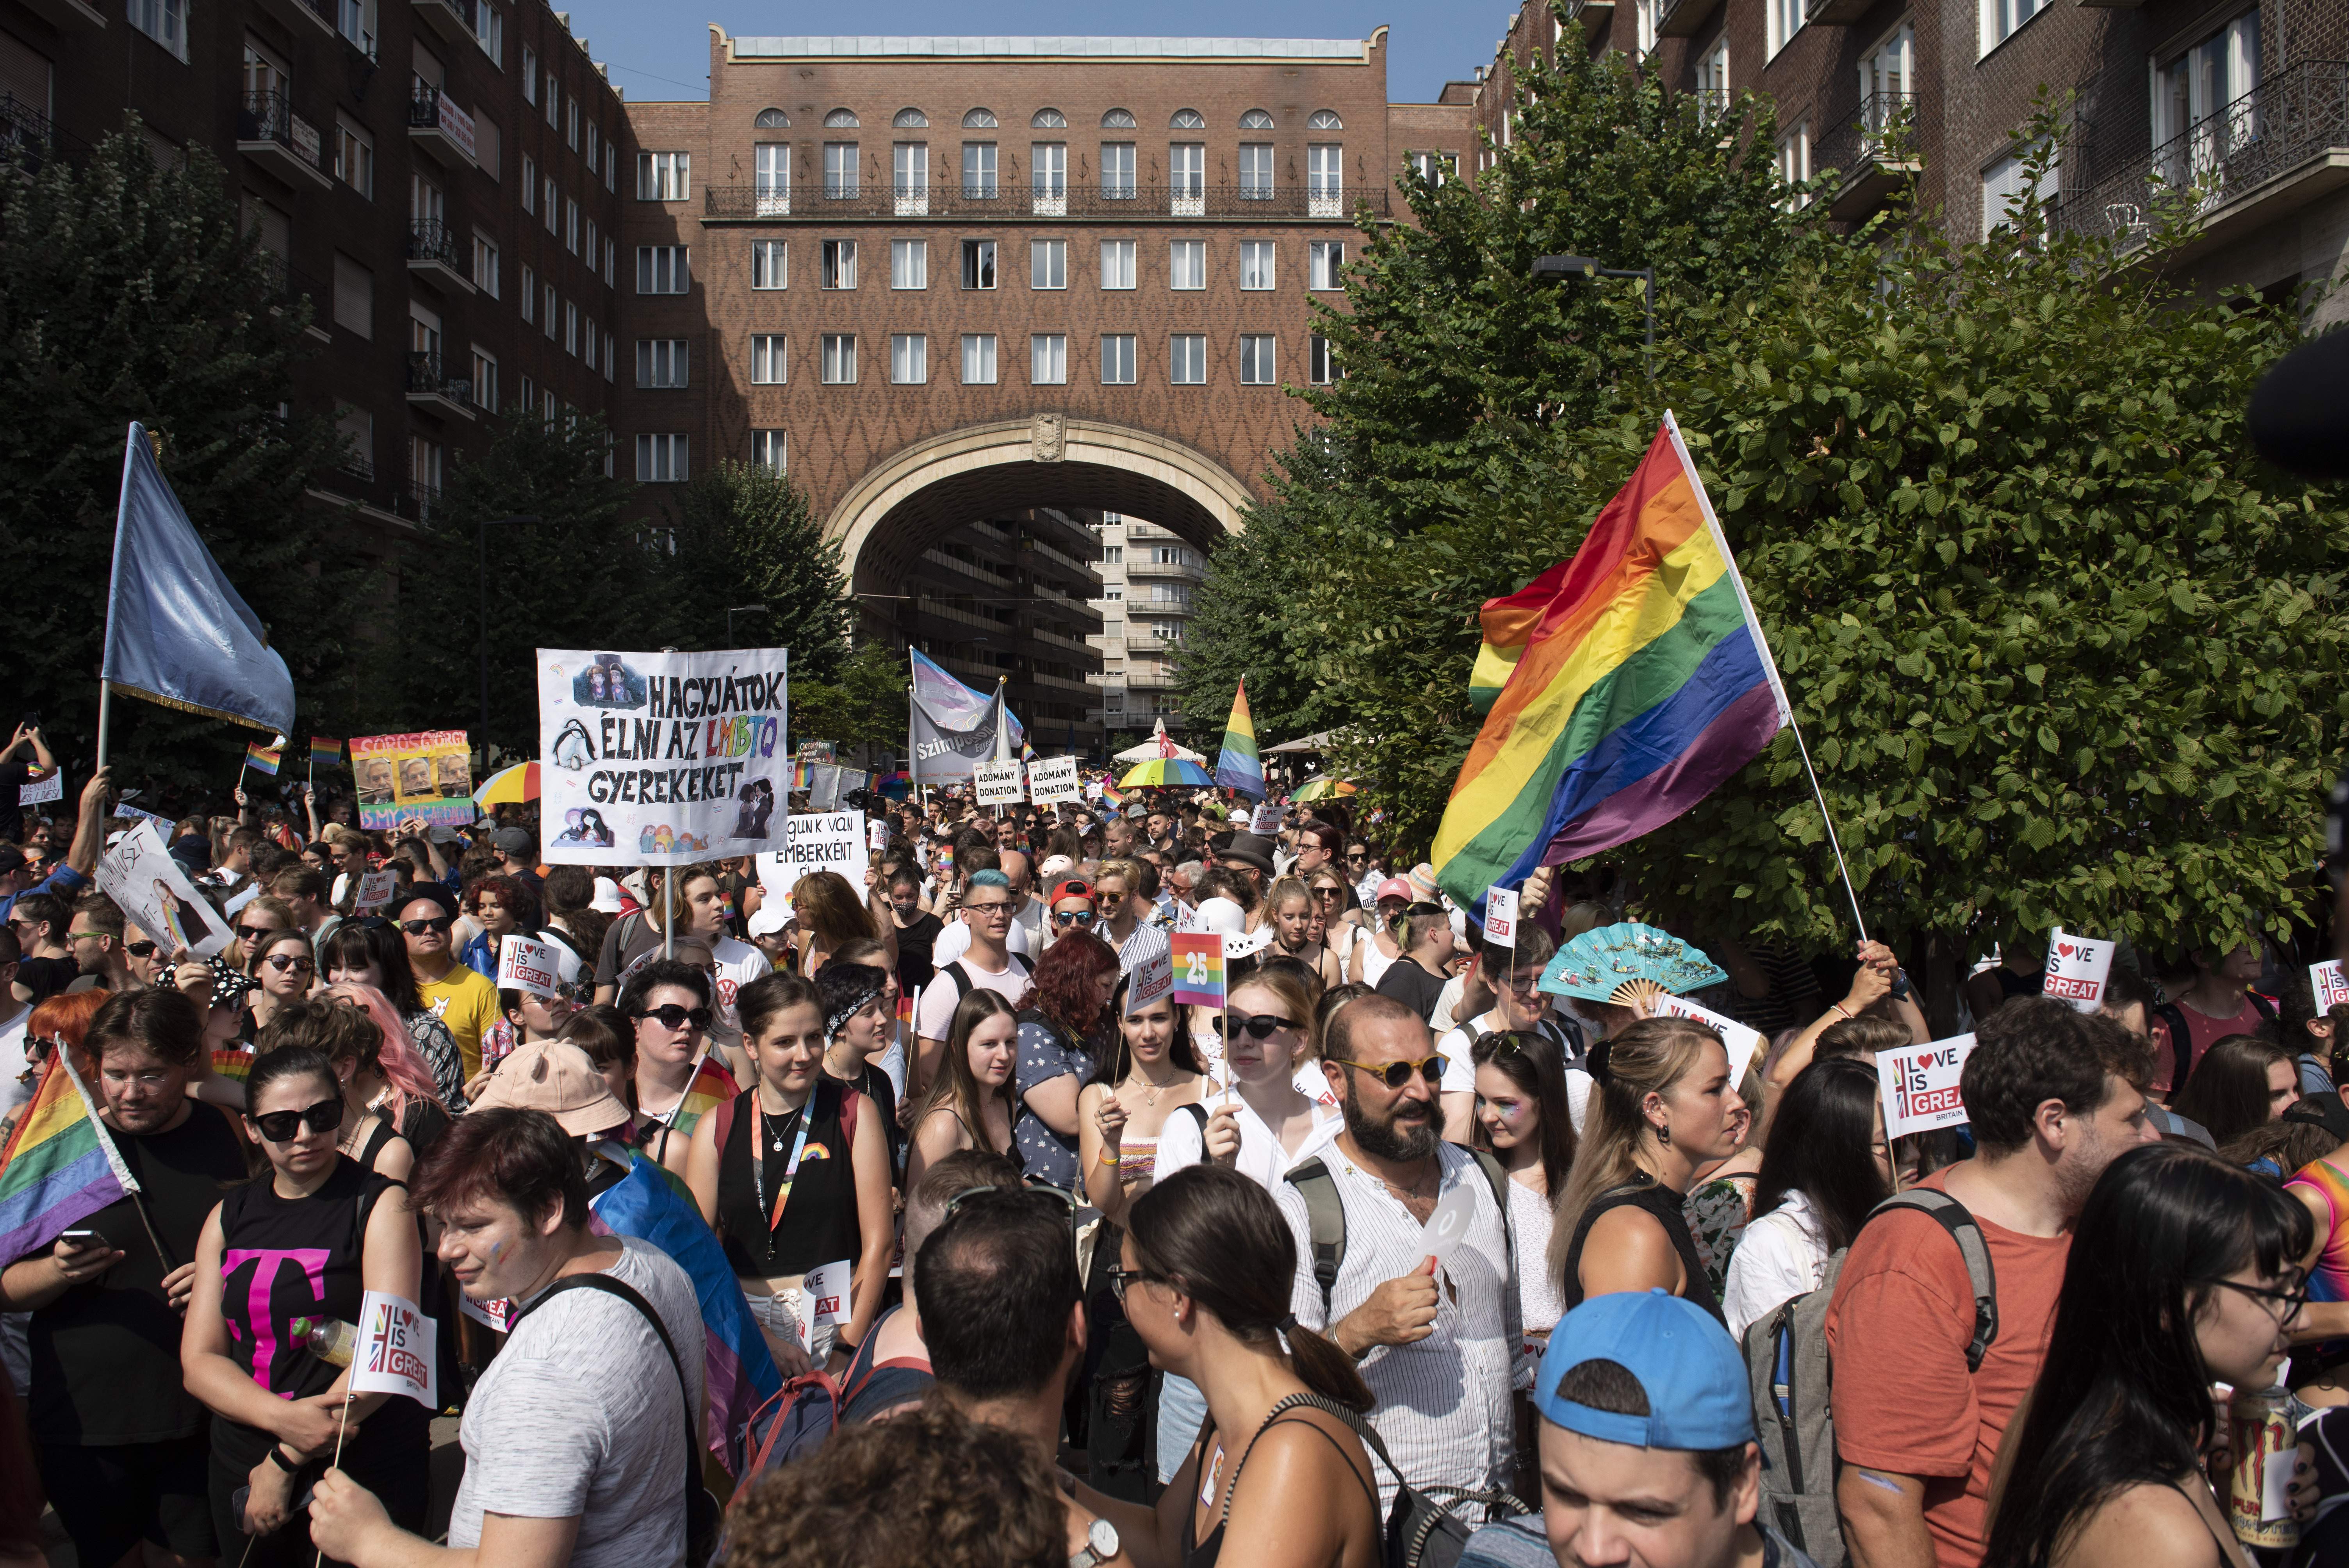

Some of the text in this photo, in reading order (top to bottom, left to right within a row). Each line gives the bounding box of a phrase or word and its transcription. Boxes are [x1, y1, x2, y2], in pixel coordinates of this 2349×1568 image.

[457, 112, 465, 128] FOR
[649, 665, 784, 719] HAGYJÁTOK
[356, 731, 467, 758] SOROS GYÖRGY
[602, 711, 778, 761] ÉLNI AZ LMBTQ
[978, 769, 1015, 783] ADOMÁNY
[1034, 767, 1071, 782] ADOMÁNY
[588, 762, 745, 805] GYEREKEKET
[979, 785, 1017, 797] DONATION
[1034, 782, 1075, 796] DONATION
[360, 809, 373, 829] IS
[375, 808, 399, 827] MY
[788, 818, 822, 842] guNK
[776, 838, 852, 864] EMBERKÉNT
[369, 889, 388, 900] GREAT
[1489, 919, 1508, 934] GREAT
[517, 953, 528, 965] IS
[2046, 956, 2060, 973] IS
[517, 967, 551, 985] GREAT
[1185, 952, 1208, 986] 25
[1143, 975, 1172, 996] GREAT
[1144, 973, 1152, 986] IS
[2044, 975, 2098, 998] GREAT
[2330, 977, 2344, 989] IS
[1150, 991, 1163, 1001] BRITAIN
[1909, 1074, 1928, 1092] IS
[1936, 1110, 1963, 1121] BRITAIN
[483, 1313, 500, 1324] BRITAIN
[391, 1327, 406, 1348] IS
[391, 1352, 426, 1385] GREAT
[406, 1380, 420, 1393] BRITAIN
